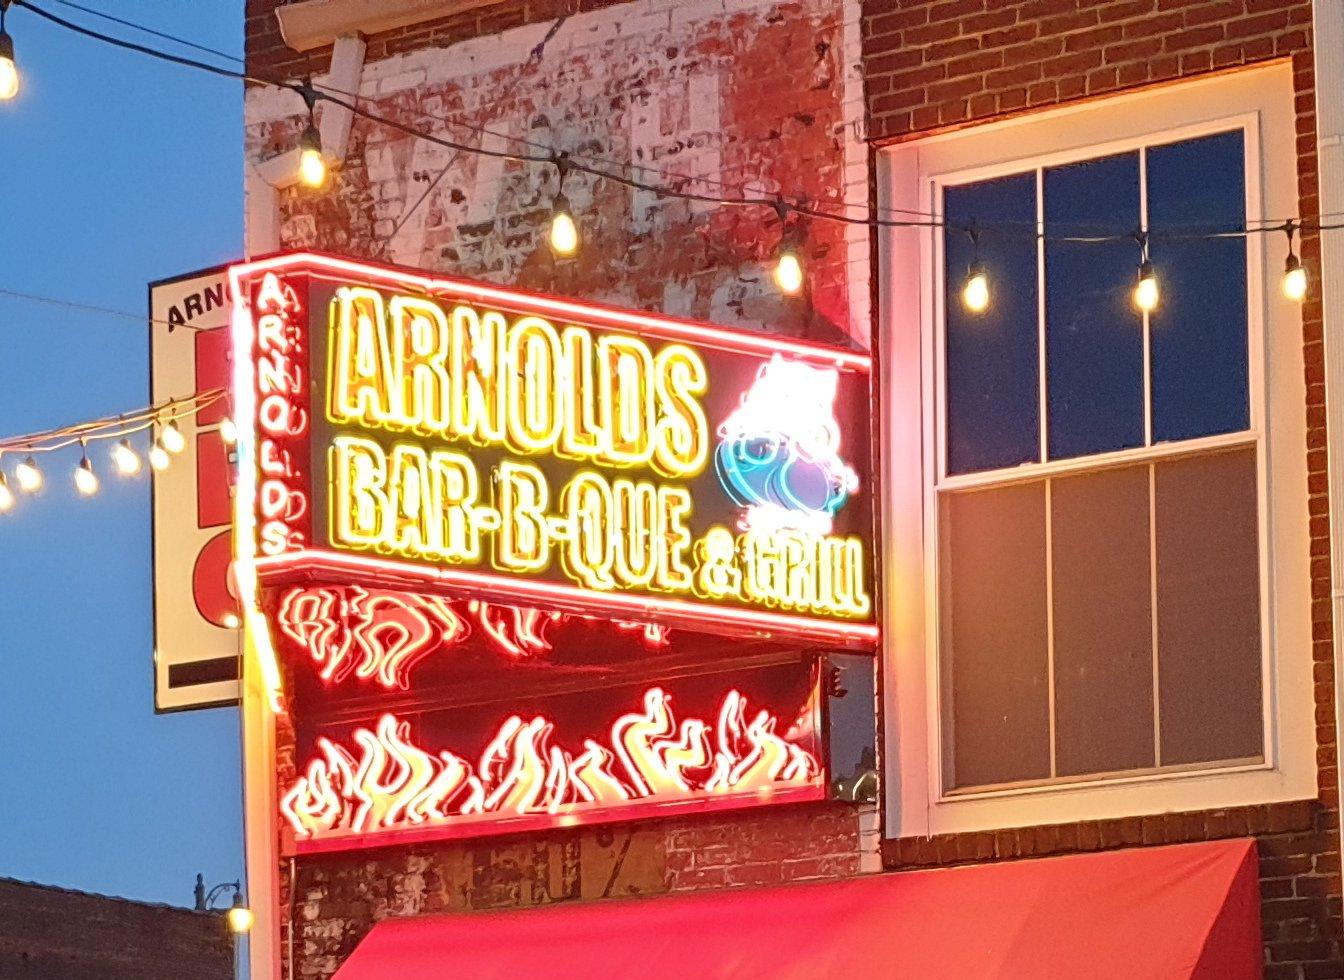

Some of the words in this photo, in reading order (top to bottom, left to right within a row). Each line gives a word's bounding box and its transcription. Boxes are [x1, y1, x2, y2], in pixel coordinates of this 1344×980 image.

[258, 272, 302, 556] ARNOLDS
[328, 287, 708, 478] ARNOLDS
[329, 436, 692, 591] BAR-B-QUE
[695, 523, 741, 598] &
[745, 528, 870, 616] GRILL
